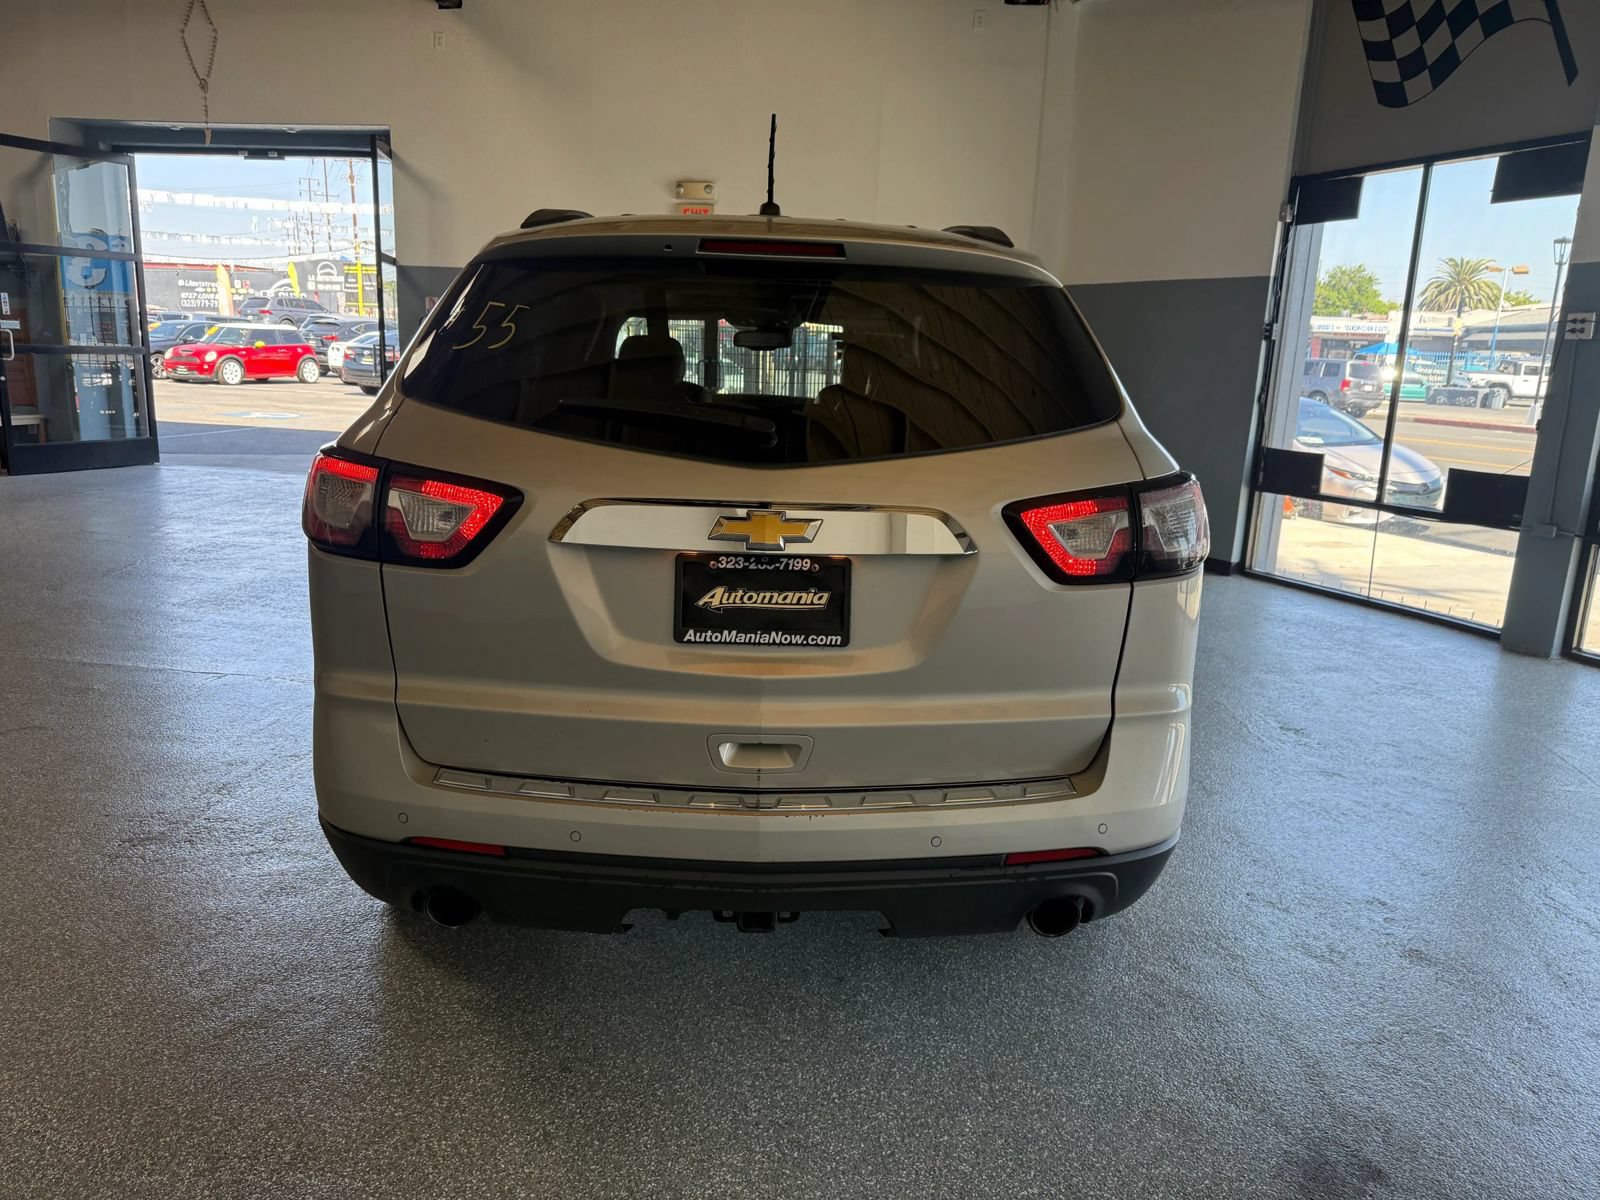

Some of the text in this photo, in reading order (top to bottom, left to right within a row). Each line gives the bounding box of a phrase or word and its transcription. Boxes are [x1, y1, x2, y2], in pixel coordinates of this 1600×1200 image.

[451, 301, 531, 350] 55
[695, 585, 832, 612] Automania
[683, 629, 842, 646] AutoManiaNow.com
